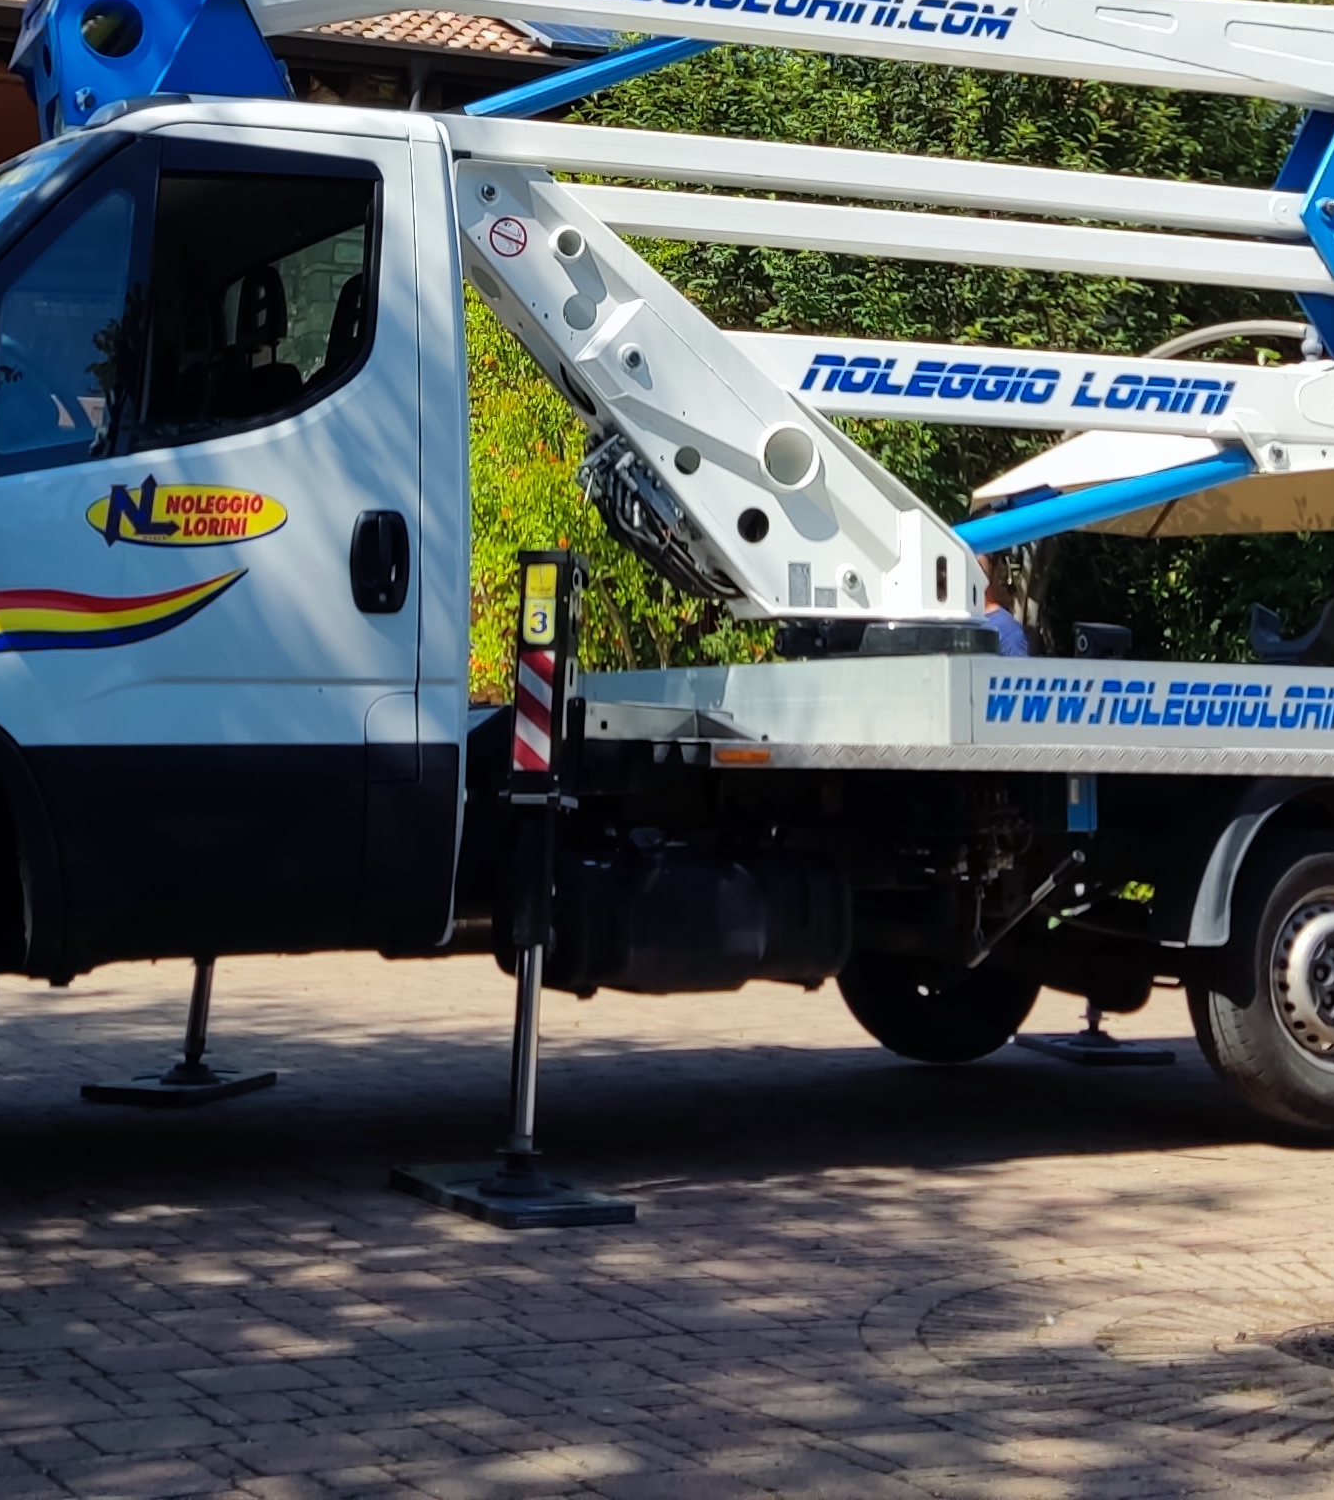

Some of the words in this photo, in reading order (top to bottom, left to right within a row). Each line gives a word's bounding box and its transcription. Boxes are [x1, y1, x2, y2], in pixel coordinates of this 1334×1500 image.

[799, 353, 1061, 404] NOLEGGIO
[1071, 371, 1237, 416] LORINI
[104, 473, 181, 548] NL
[165, 493, 264, 515] NOLEGGIO
[182, 517, 248, 537] LORINI
[530, 611, 548, 634] 3
